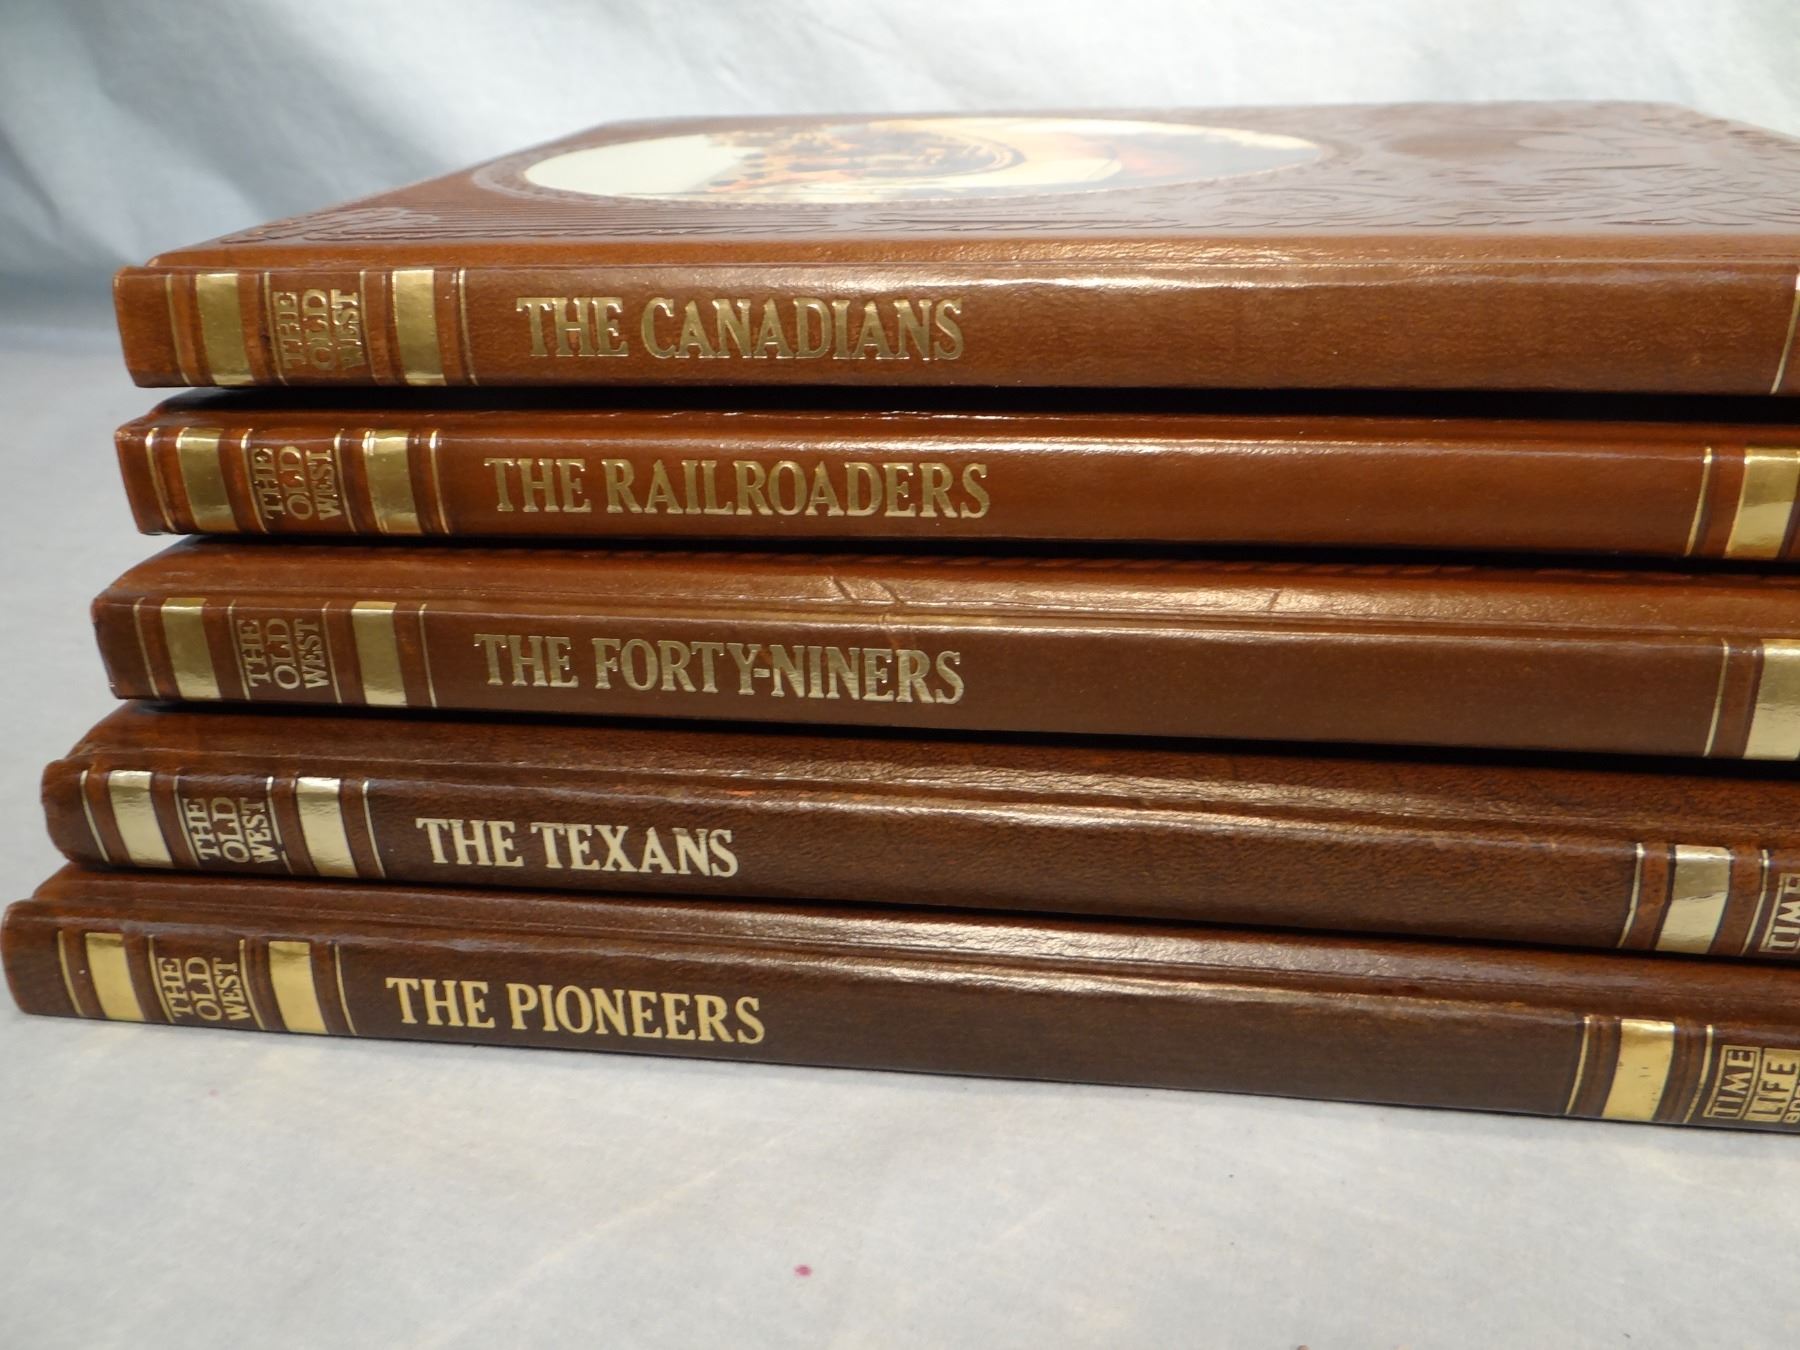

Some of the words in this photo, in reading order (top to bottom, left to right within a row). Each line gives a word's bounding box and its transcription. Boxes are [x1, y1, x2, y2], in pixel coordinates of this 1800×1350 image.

[272, 291, 307, 369] THE
[302, 288, 337, 371] OLD
[330, 289, 366, 370] WEST
[516, 296, 629, 357] THE
[640, 297, 965, 361] CANADIANS
[252, 448, 287, 520] THE
[279, 446, 313, 520] OLD
[305, 449, 342, 520] WEST
[484, 457, 592, 513] THE
[601, 458, 990, 519] RAILROADERS
[236, 619, 272, 688] THE
[266, 618, 301, 690] OLD
[294, 618, 330, 689] WEST
[473, 633, 579, 689] THE
[592, 637, 965, 705] FORTY-NINERS
[182, 798, 221, 860] THE
[211, 797, 251, 863] OLD
[240, 797, 279, 863] WEST
[415, 817, 524, 868] THE
[530, 821, 739, 878] TEXANS
[157, 957, 194, 1018] THE
[185, 956, 222, 1021] OLD
[213, 957, 251, 1021] WEST
[385, 977, 496, 1029] THE
[505, 983, 766, 1045] PIONEERS
[1711, 1050, 1755, 1117] TIME
[1751, 1061, 1797, 1115] LIFE
